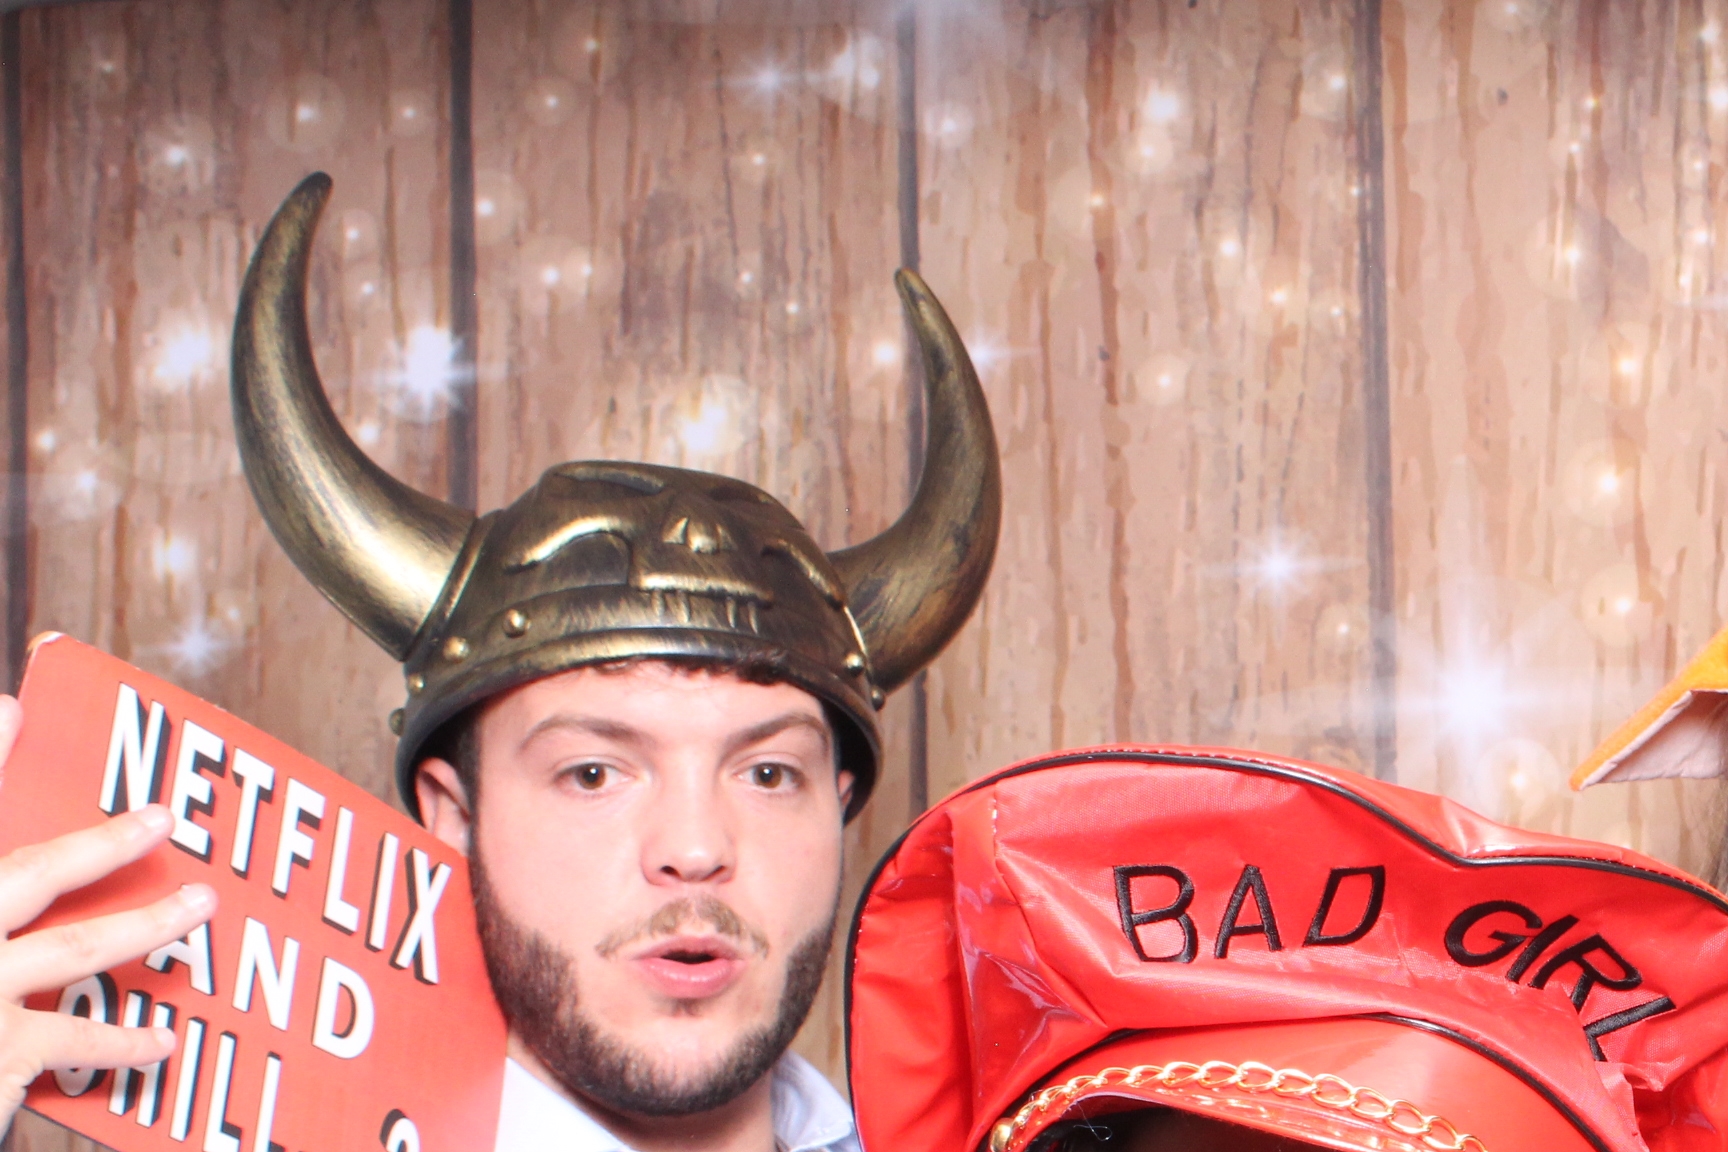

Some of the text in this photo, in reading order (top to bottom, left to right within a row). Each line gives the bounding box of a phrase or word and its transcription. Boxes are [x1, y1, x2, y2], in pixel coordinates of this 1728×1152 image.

[97, 681, 452, 985] NETFLIX
[1112, 864, 1677, 1063] BAD GIRL
